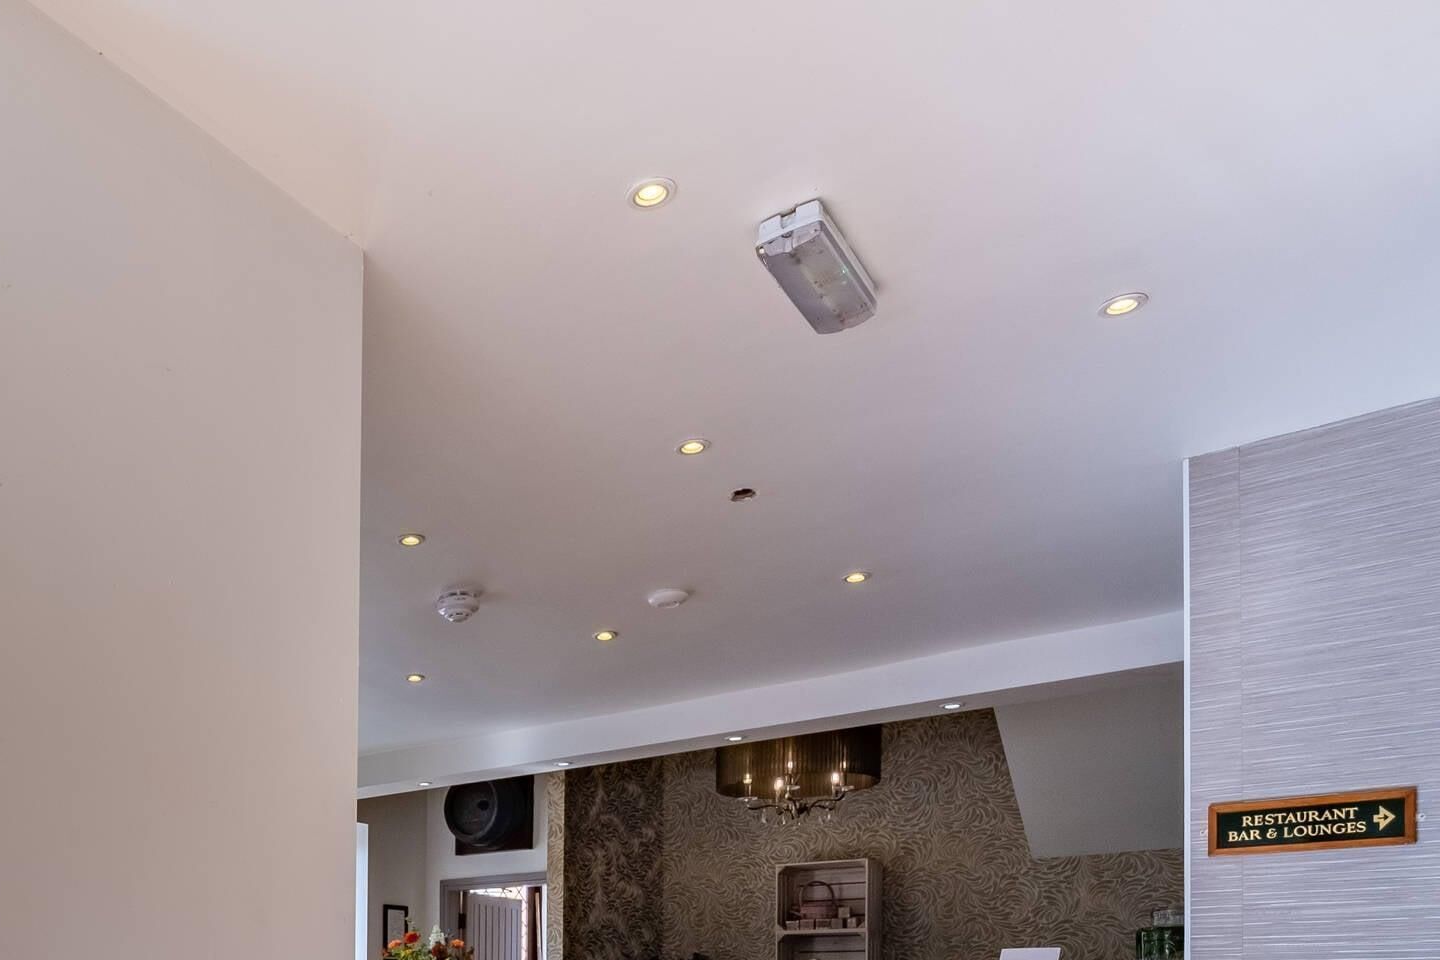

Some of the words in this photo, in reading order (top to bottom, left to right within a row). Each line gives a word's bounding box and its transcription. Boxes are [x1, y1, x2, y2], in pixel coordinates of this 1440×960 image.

[1242, 807, 1358, 827] RESTAURANT
[1228, 829, 1261, 842] BAR
[1266, 828, 1277, 839] &
[1283, 821, 1366, 838] LOUNGES
